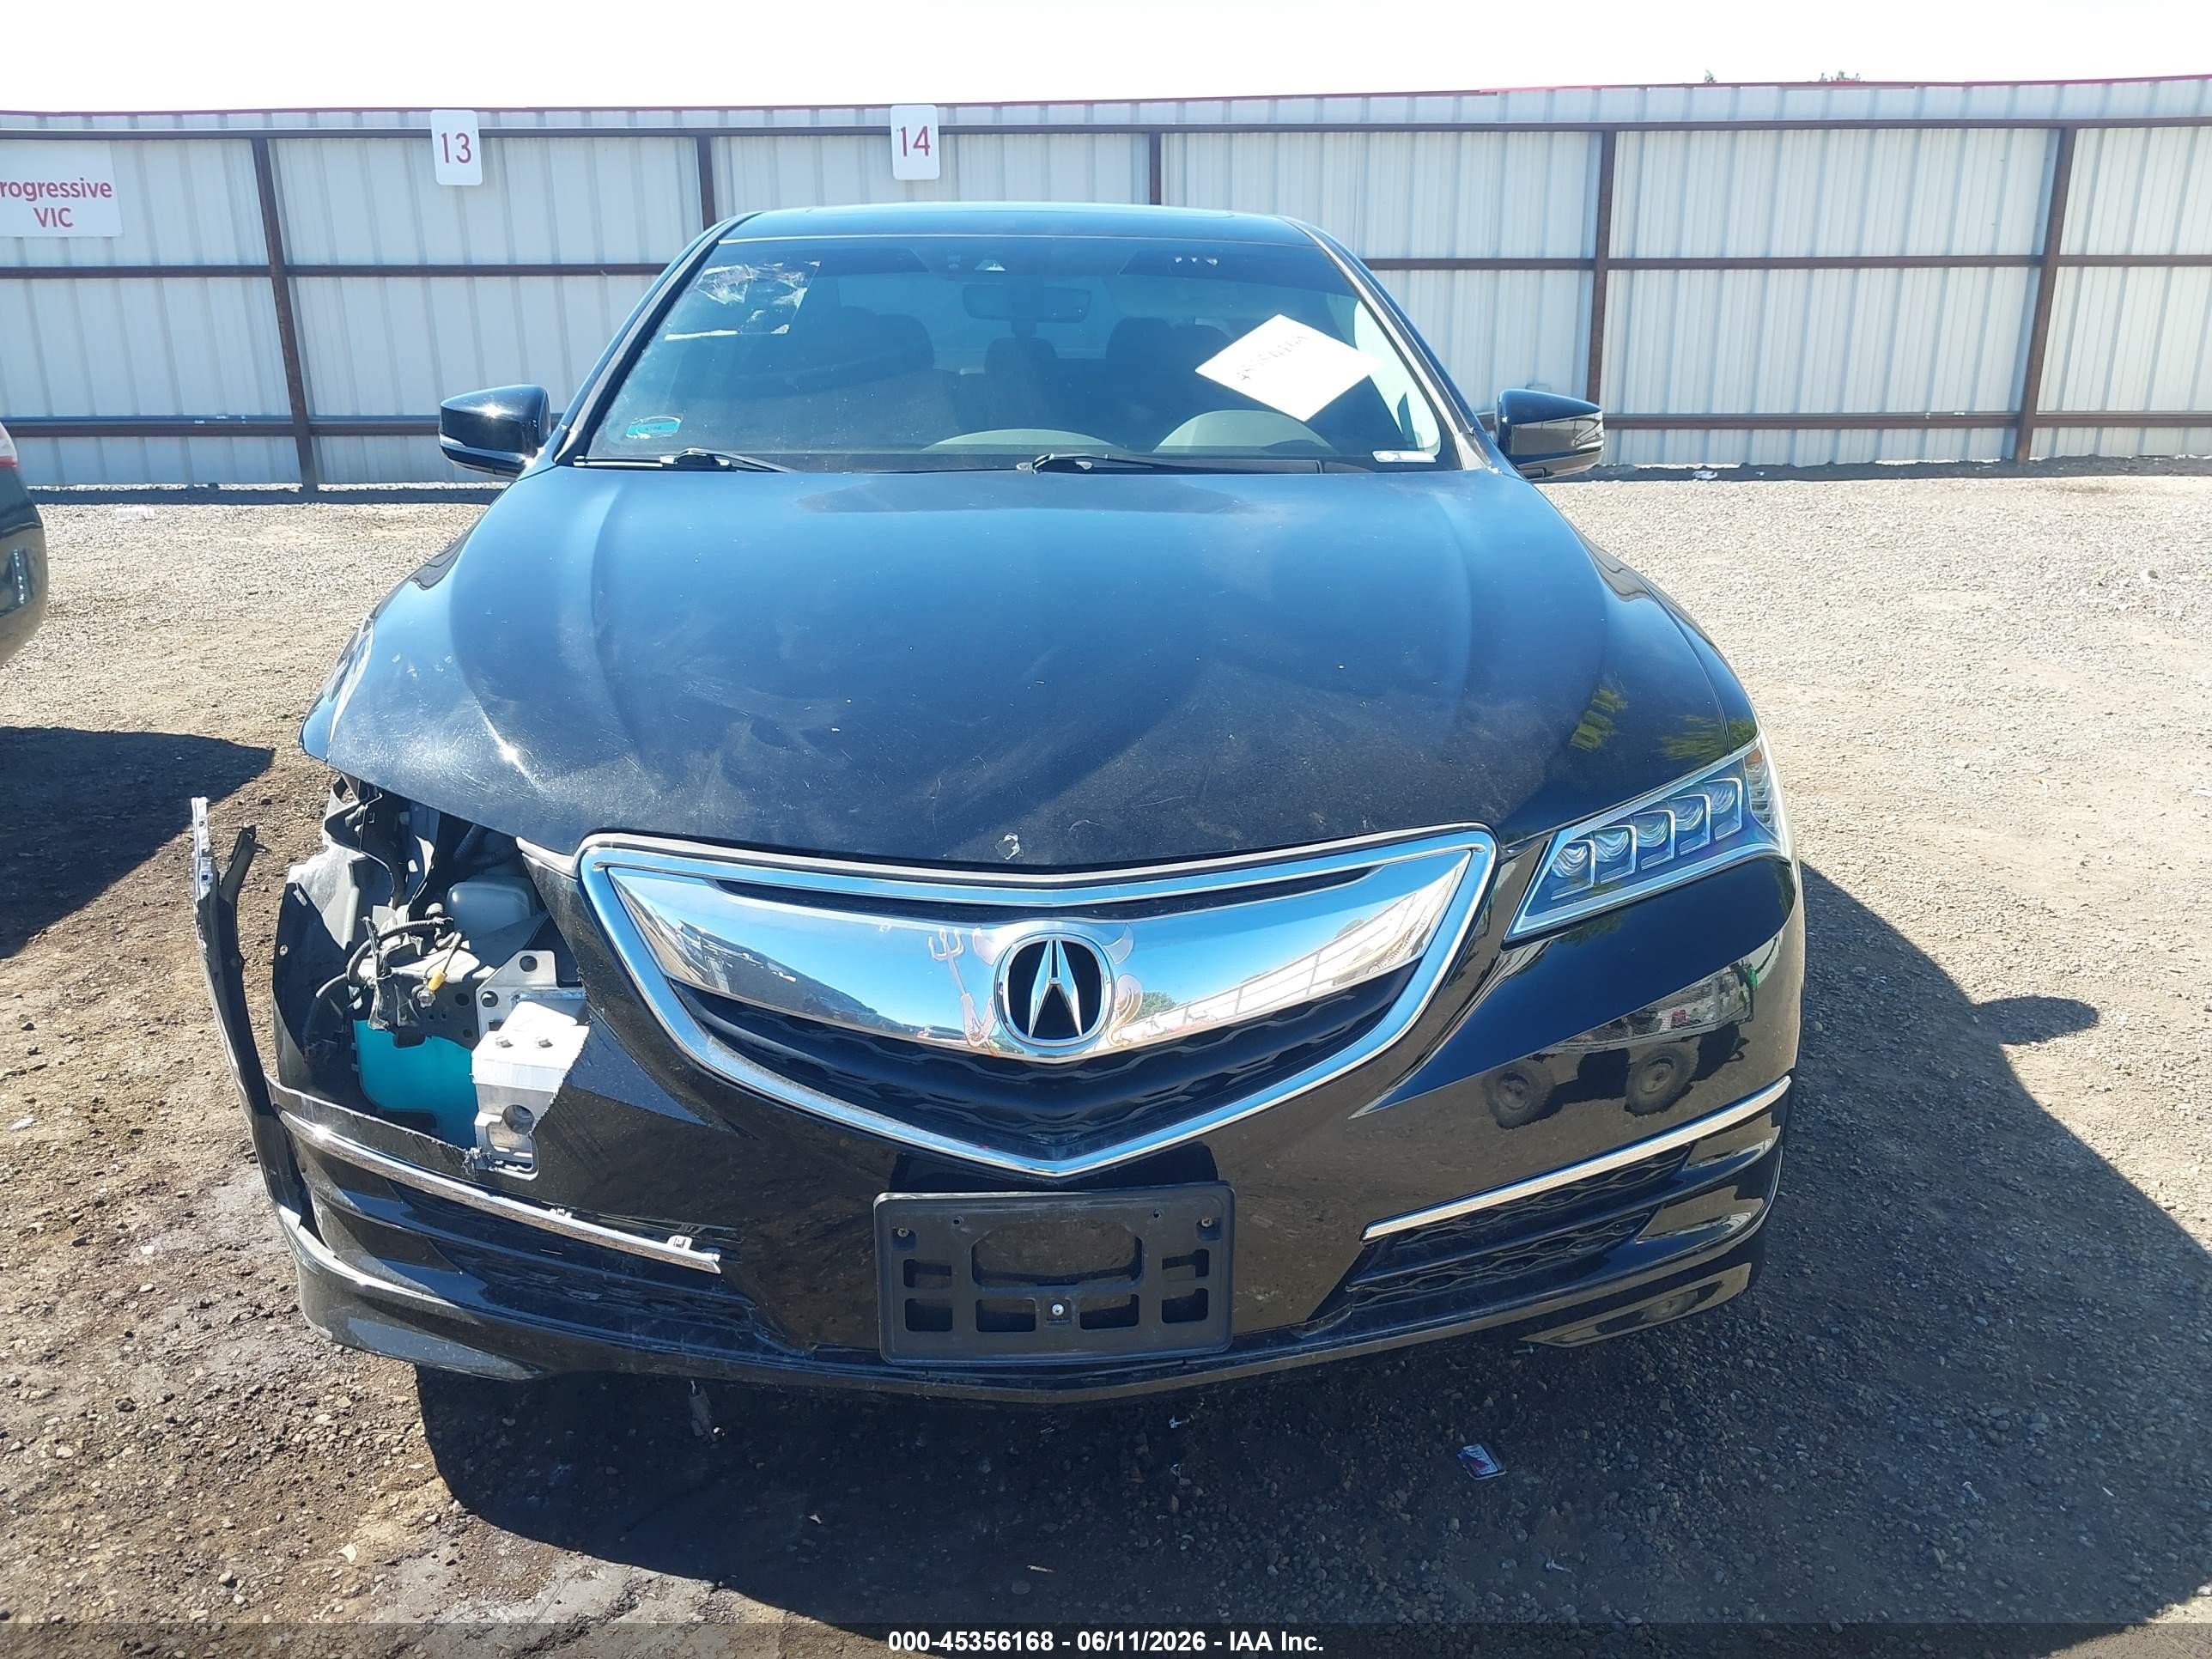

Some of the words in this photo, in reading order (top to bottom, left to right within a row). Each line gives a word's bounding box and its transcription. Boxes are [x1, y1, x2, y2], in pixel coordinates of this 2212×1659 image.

[441, 132, 471, 164] 13
[900, 125, 931, 157] 14
[0, 177, 112, 202] rogressive
[33, 207, 74, 228] VIC
